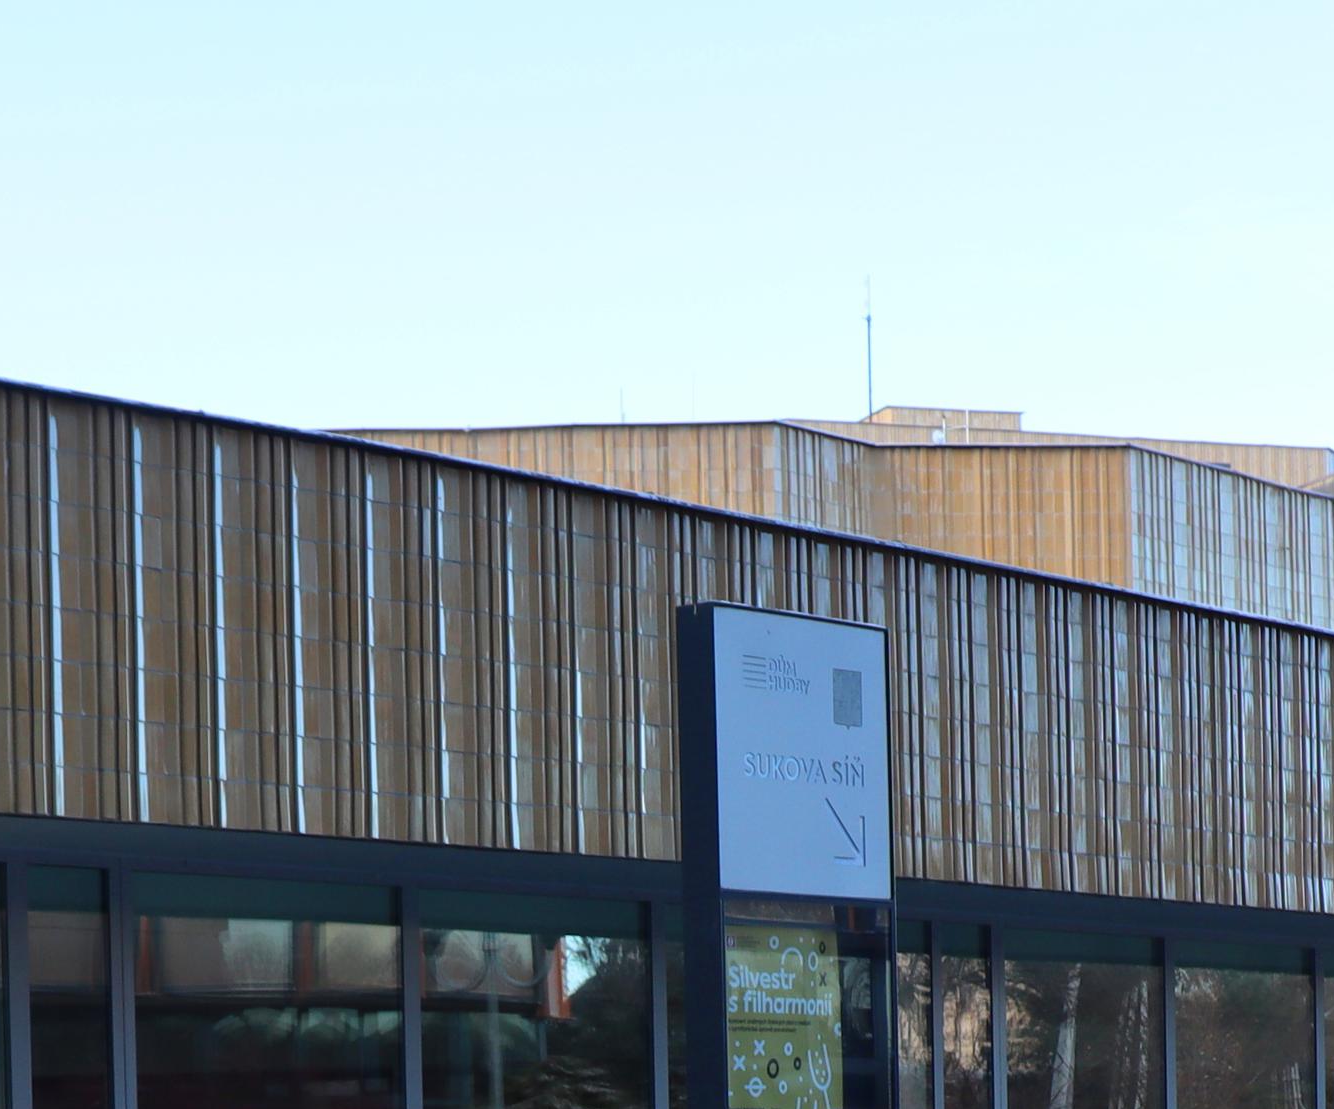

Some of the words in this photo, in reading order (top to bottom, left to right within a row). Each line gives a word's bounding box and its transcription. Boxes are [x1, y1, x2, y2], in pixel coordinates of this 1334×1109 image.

[743, 751, 828, 785] SUKOVA
[831, 755, 866, 788] SÍŇ
[729, 964, 796, 989] Silvestr
[728, 995, 738, 1013] s
